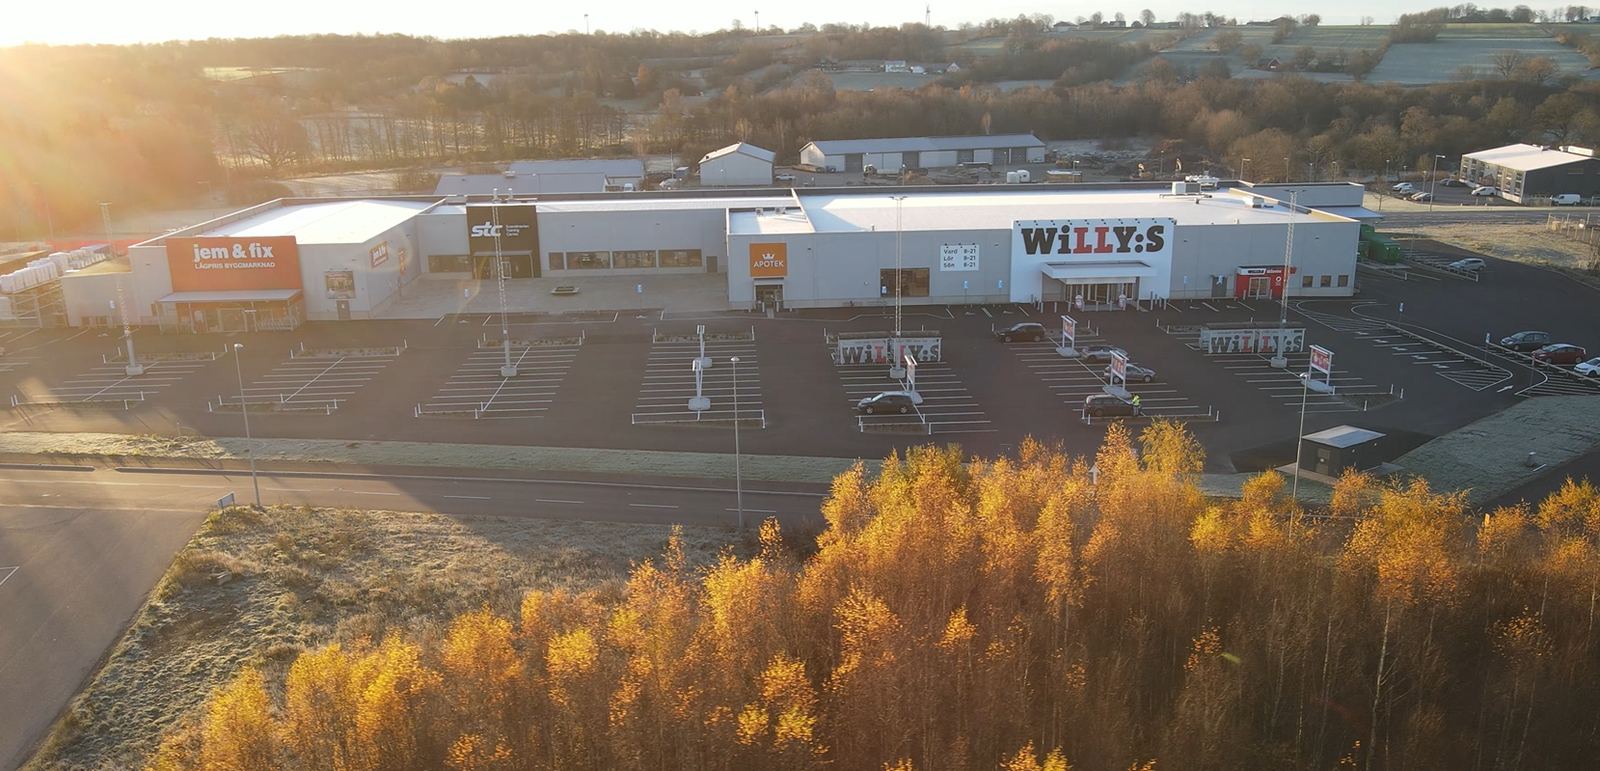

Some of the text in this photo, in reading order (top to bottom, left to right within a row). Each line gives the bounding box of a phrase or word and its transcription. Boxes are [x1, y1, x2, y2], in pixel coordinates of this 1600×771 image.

[1021, 224, 1165, 255] WiLLY:S
[193, 243, 274, 262] jem & fix
[753, 260, 785, 268] APOTEK
